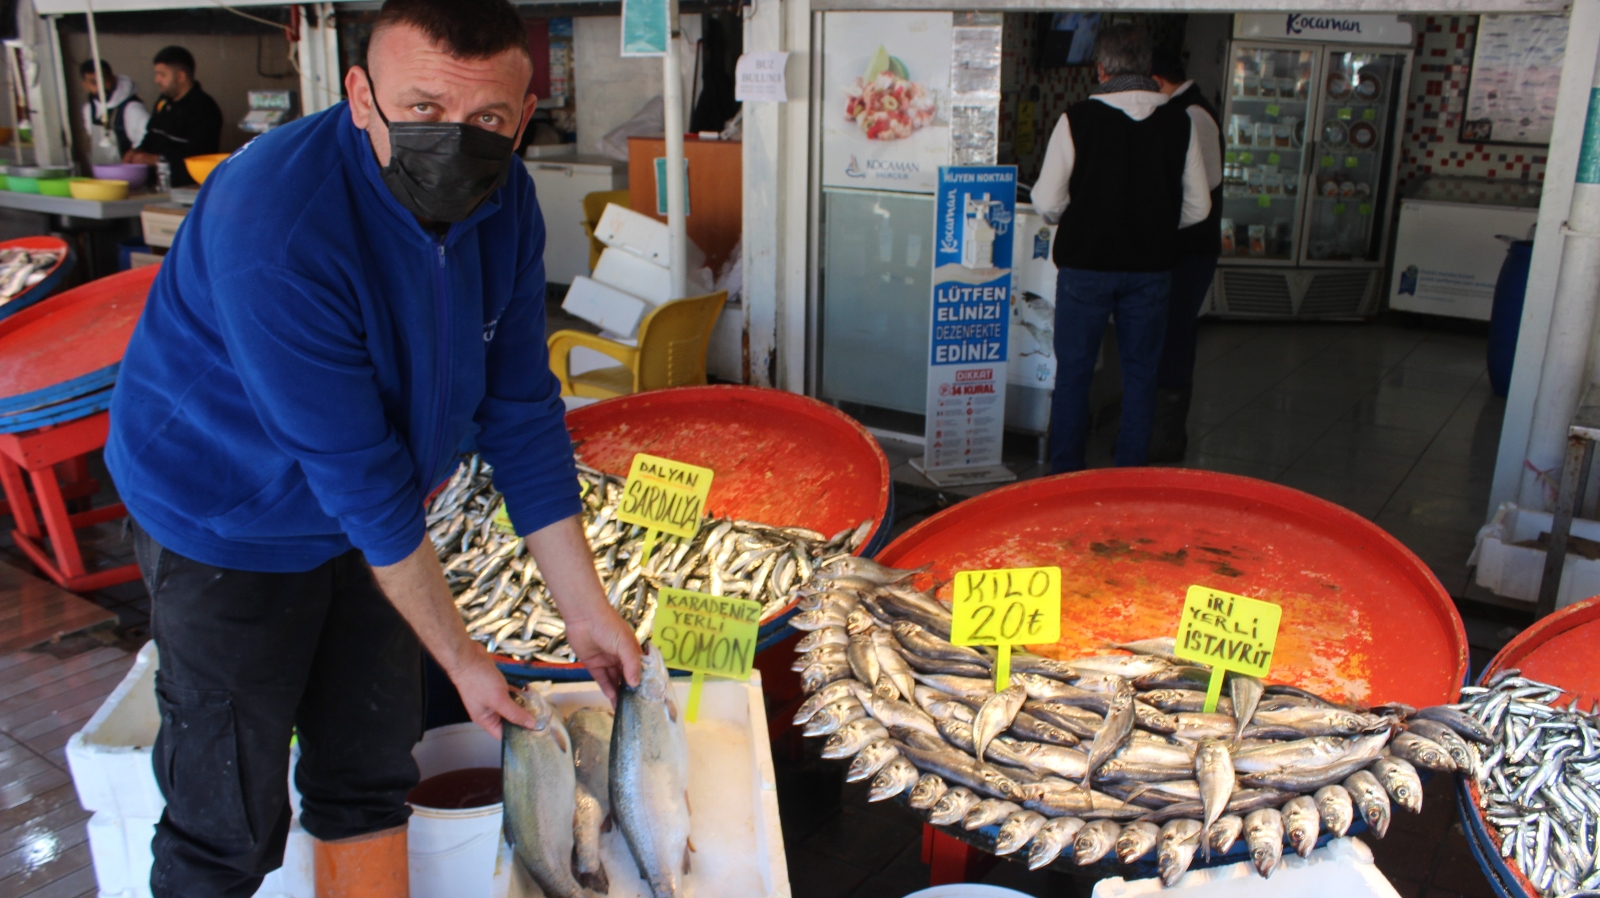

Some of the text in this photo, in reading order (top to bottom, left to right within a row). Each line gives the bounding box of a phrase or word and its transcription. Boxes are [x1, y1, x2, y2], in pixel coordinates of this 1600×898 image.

[1286, 13, 1361, 35] Kocaman
[866, 159, 919, 172] KOCAMAN
[976, 172, 1013, 183] NOKTASI
[940, 188, 958, 254] Kocaman
[938, 285, 1006, 303] LÜTFEN
[937, 302, 1000, 322] ELİNİZİ
[936, 323, 1002, 340] DEZENFEKTE
[935, 339, 1001, 363] EDİNİZ
[964, 384, 995, 395] KURAL
[639, 461, 699, 488] DALYAN
[622, 479, 701, 530] SARDALYA
[666, 594, 759, 624] KARADENİZ
[1207, 593, 1235, 617] İRİ
[672, 610, 725, 632] YERLİ
[1190, 606, 1259, 639] YERLİ
[660, 626, 752, 675] SOMON
[1183, 622, 1272, 669] İSTAVRİT
